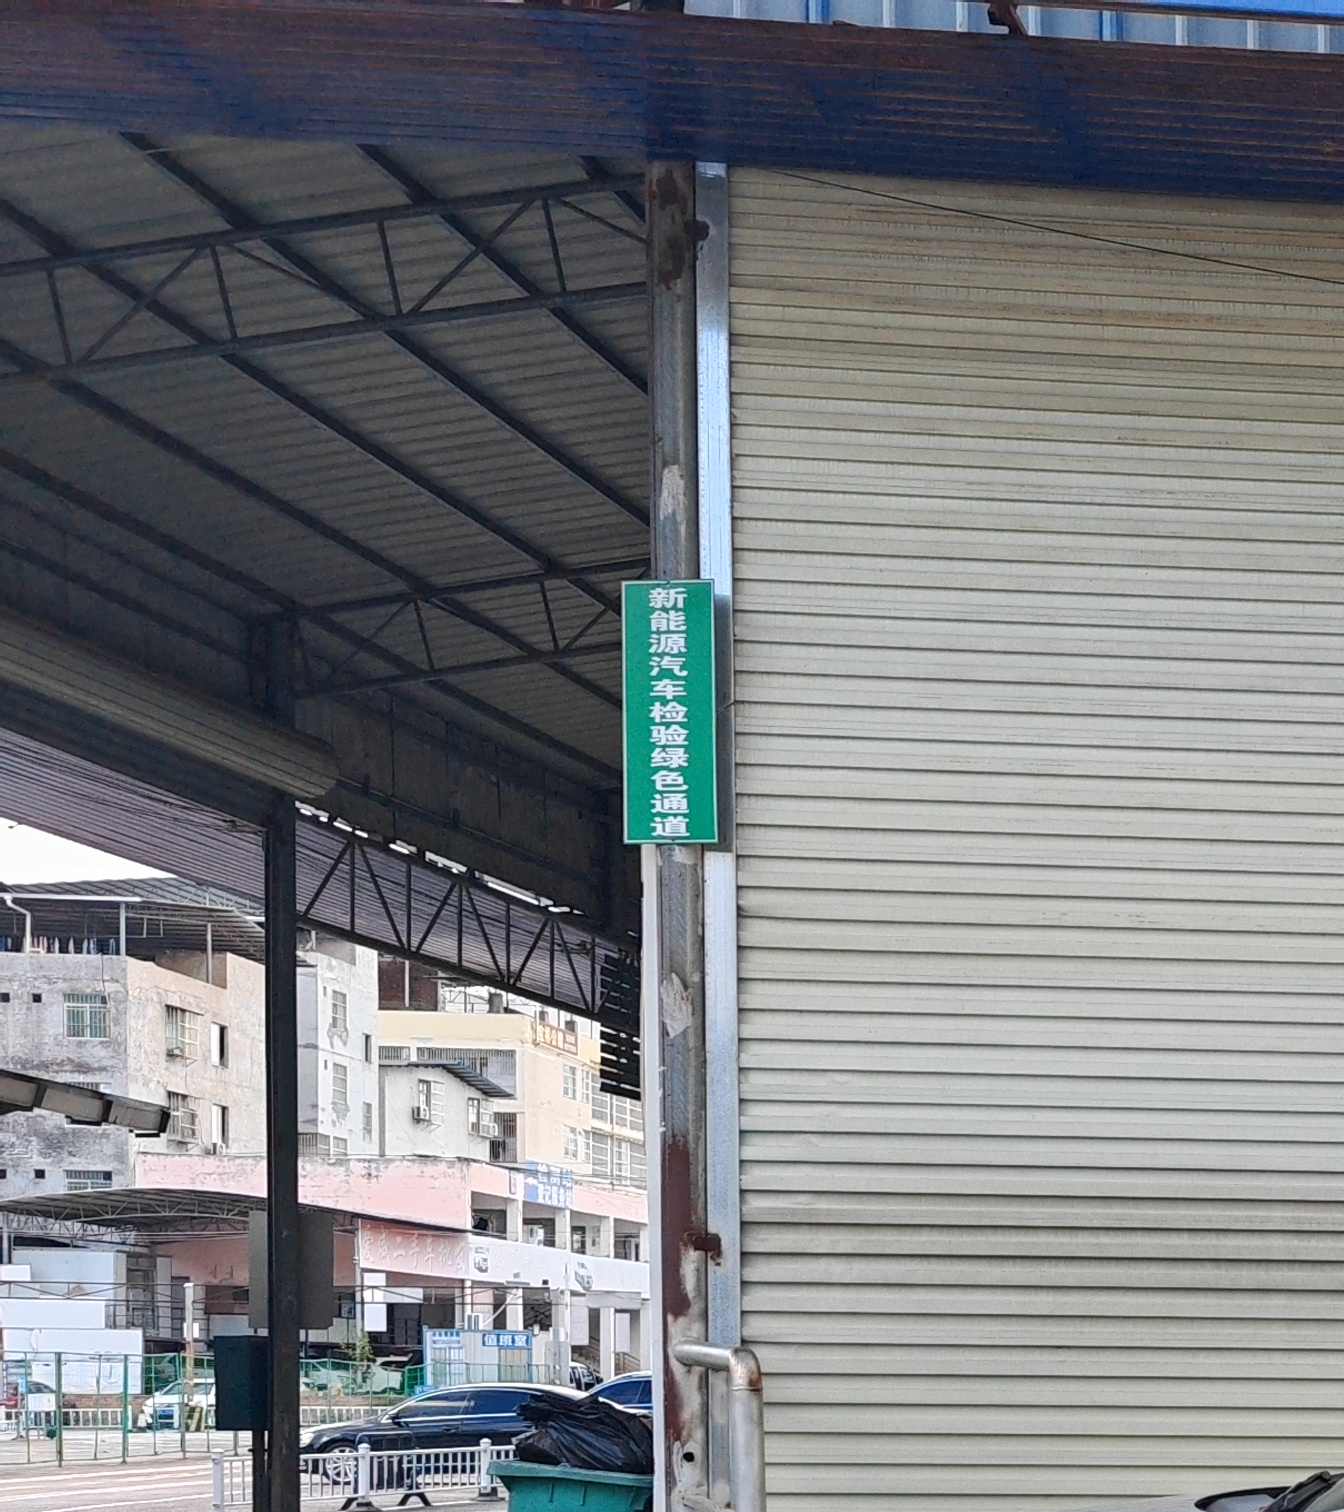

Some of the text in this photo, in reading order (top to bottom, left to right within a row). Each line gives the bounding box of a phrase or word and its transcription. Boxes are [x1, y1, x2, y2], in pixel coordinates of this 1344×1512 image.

[649, 587, 690, 837] 新能源汽车检验绿色通道
